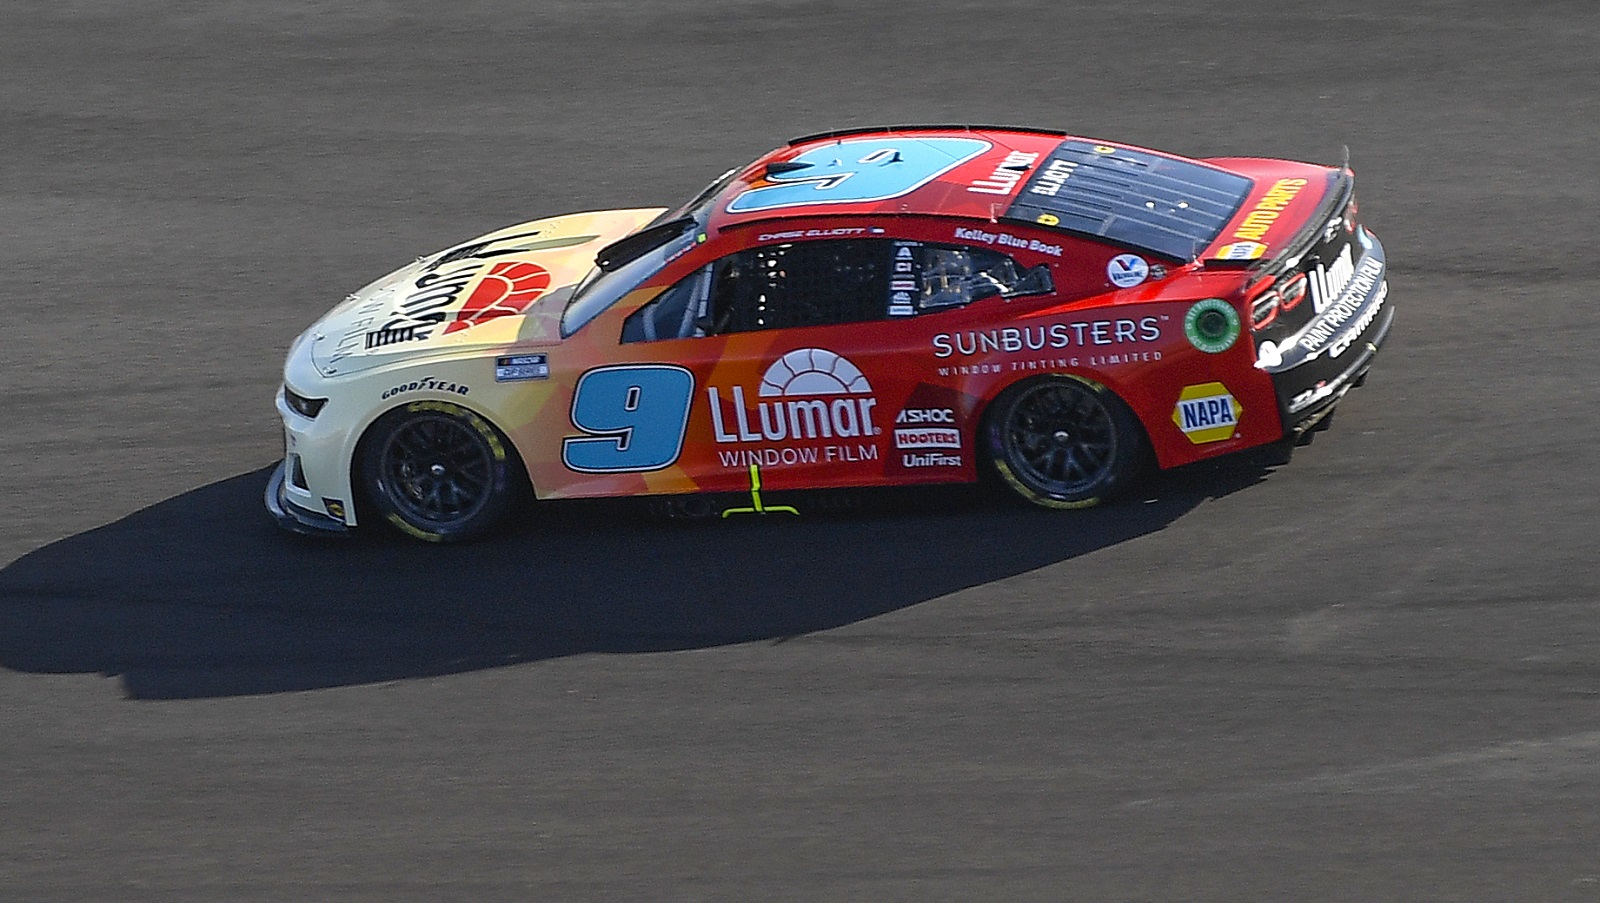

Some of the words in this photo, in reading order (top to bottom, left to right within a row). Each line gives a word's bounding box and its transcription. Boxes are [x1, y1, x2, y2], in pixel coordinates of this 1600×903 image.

[725, 137, 993, 213] 9
[1255, 178, 1308, 211] PARTS
[806, 228, 866, 236] ELLIOTT
[1233, 210, 1280, 240] AUTO
[954, 227, 998, 244] Kelley
[998, 233, 1029, 248] Blue
[1029, 239, 1063, 256] Book
[1299, 320, 1336, 351] PAINT
[1323, 273, 1377, 327] PROTECTION
[933, 316, 1162, 358] SUNBUSTERS
[938, 364, 1002, 377] WINDOW
[1011, 357, 1079, 370] TINTING
[1090, 351, 1162, 366] LIMITED
[382, 377, 469, 399] GOODYEAR
[563, 364, 694, 472] 9
[708, 386, 877, 443] LLumar
[1183, 398, 1233, 428] NAPA
[898, 432, 958, 445] HOOTERS
[718, 447, 818, 467] WINDOW
[824, 444, 879, 463] FILM
[903, 453, 962, 467] UniFirst
